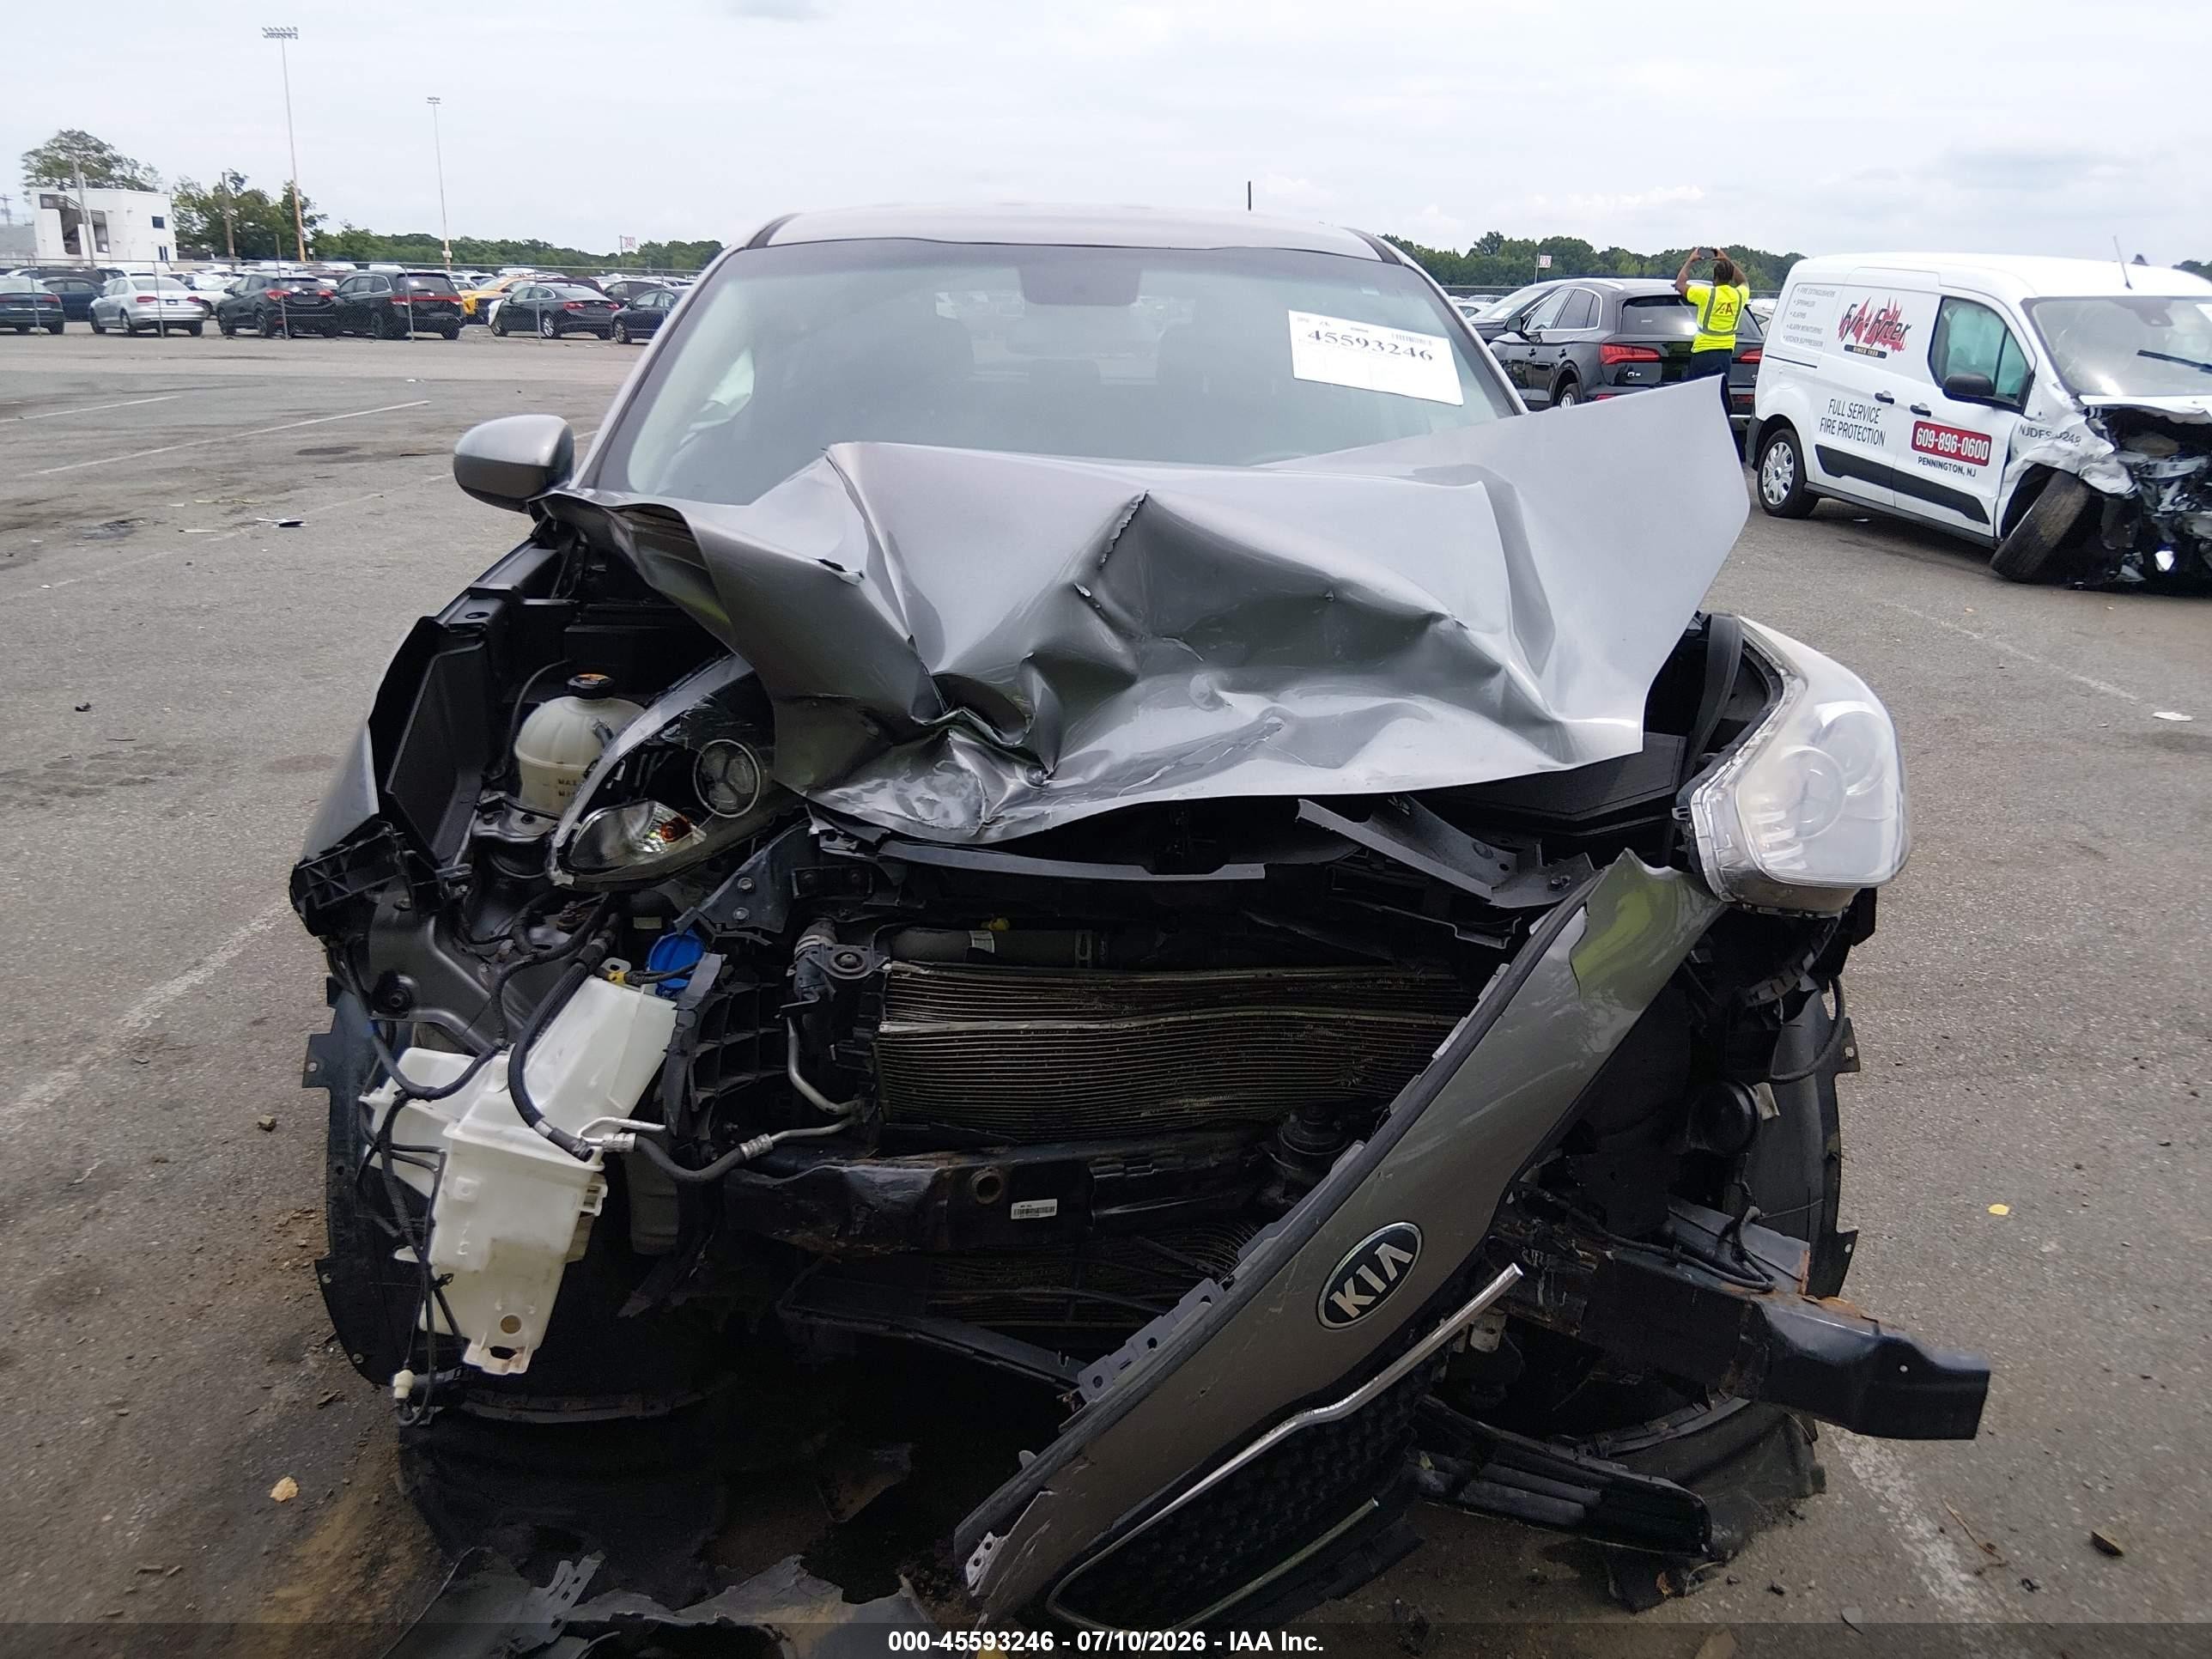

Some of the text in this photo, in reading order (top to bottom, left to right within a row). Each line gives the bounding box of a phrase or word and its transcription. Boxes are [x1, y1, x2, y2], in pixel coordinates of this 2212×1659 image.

[1308, 330, 1433, 362] 45593246
[1828, 398, 1881, 424] FULL SERVICE
[1819, 417, 1887, 447] FIRE PROTECTION
[1916, 427, 1990, 461] 609-896-0600
[1917, 456, 1977, 477] PENNINGTON, NJ
[1329, 1243, 1414, 1319] KIA
